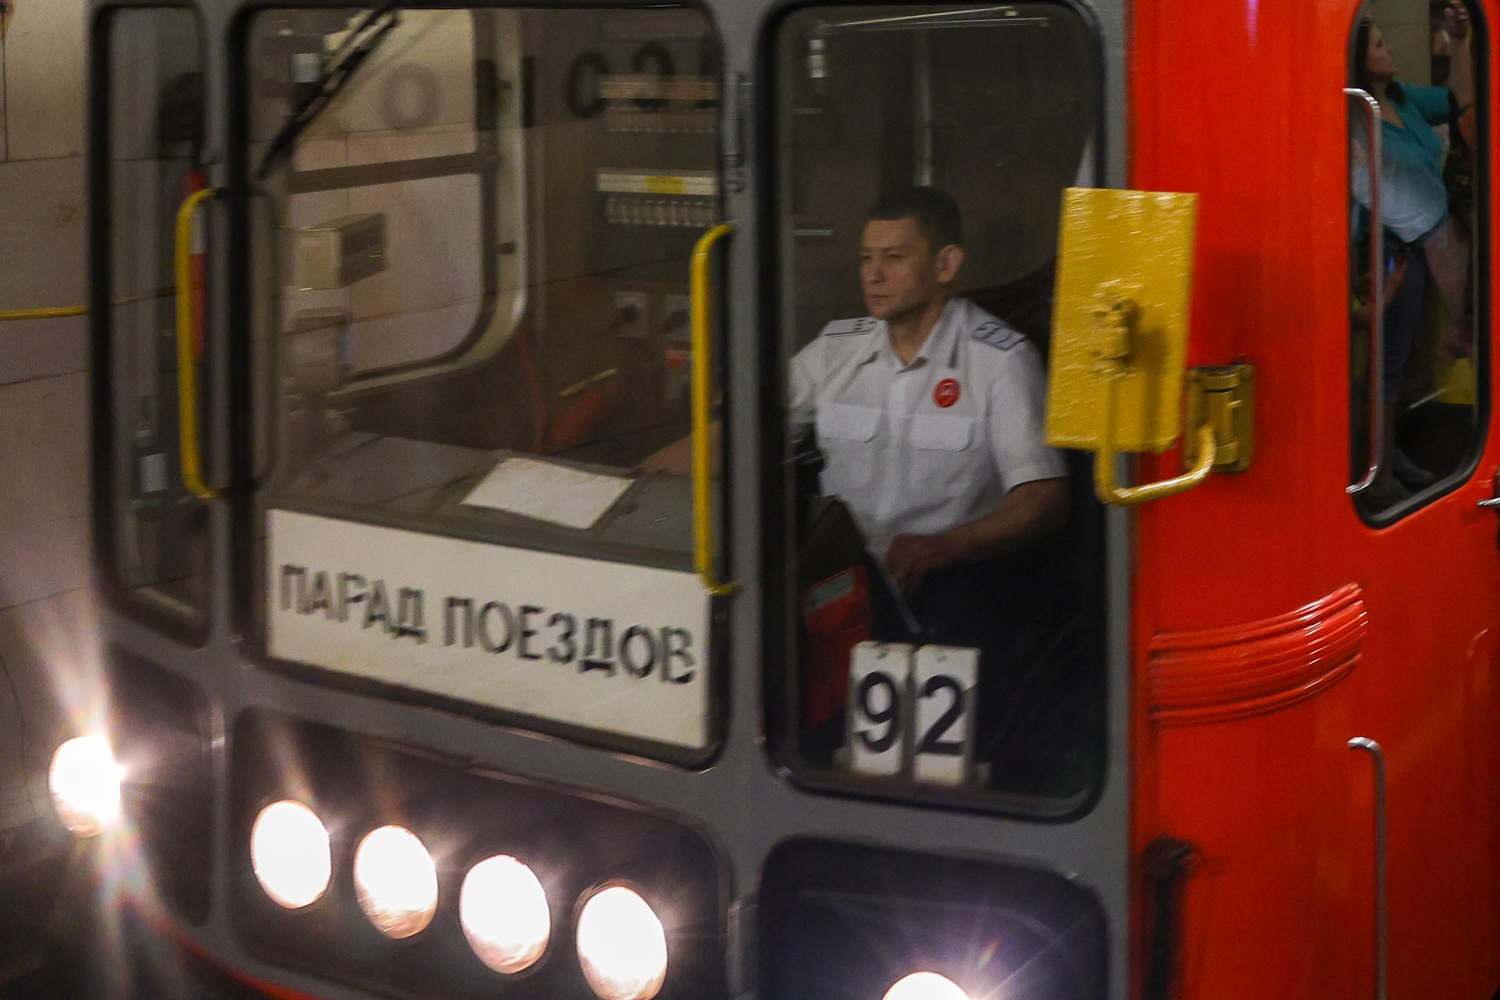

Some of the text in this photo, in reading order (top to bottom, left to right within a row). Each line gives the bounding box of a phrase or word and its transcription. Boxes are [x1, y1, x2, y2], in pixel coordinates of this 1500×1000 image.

[279, 564, 696, 684] ПАРАД ПОЕЗДОВ
[854, 671, 967, 756] 92
